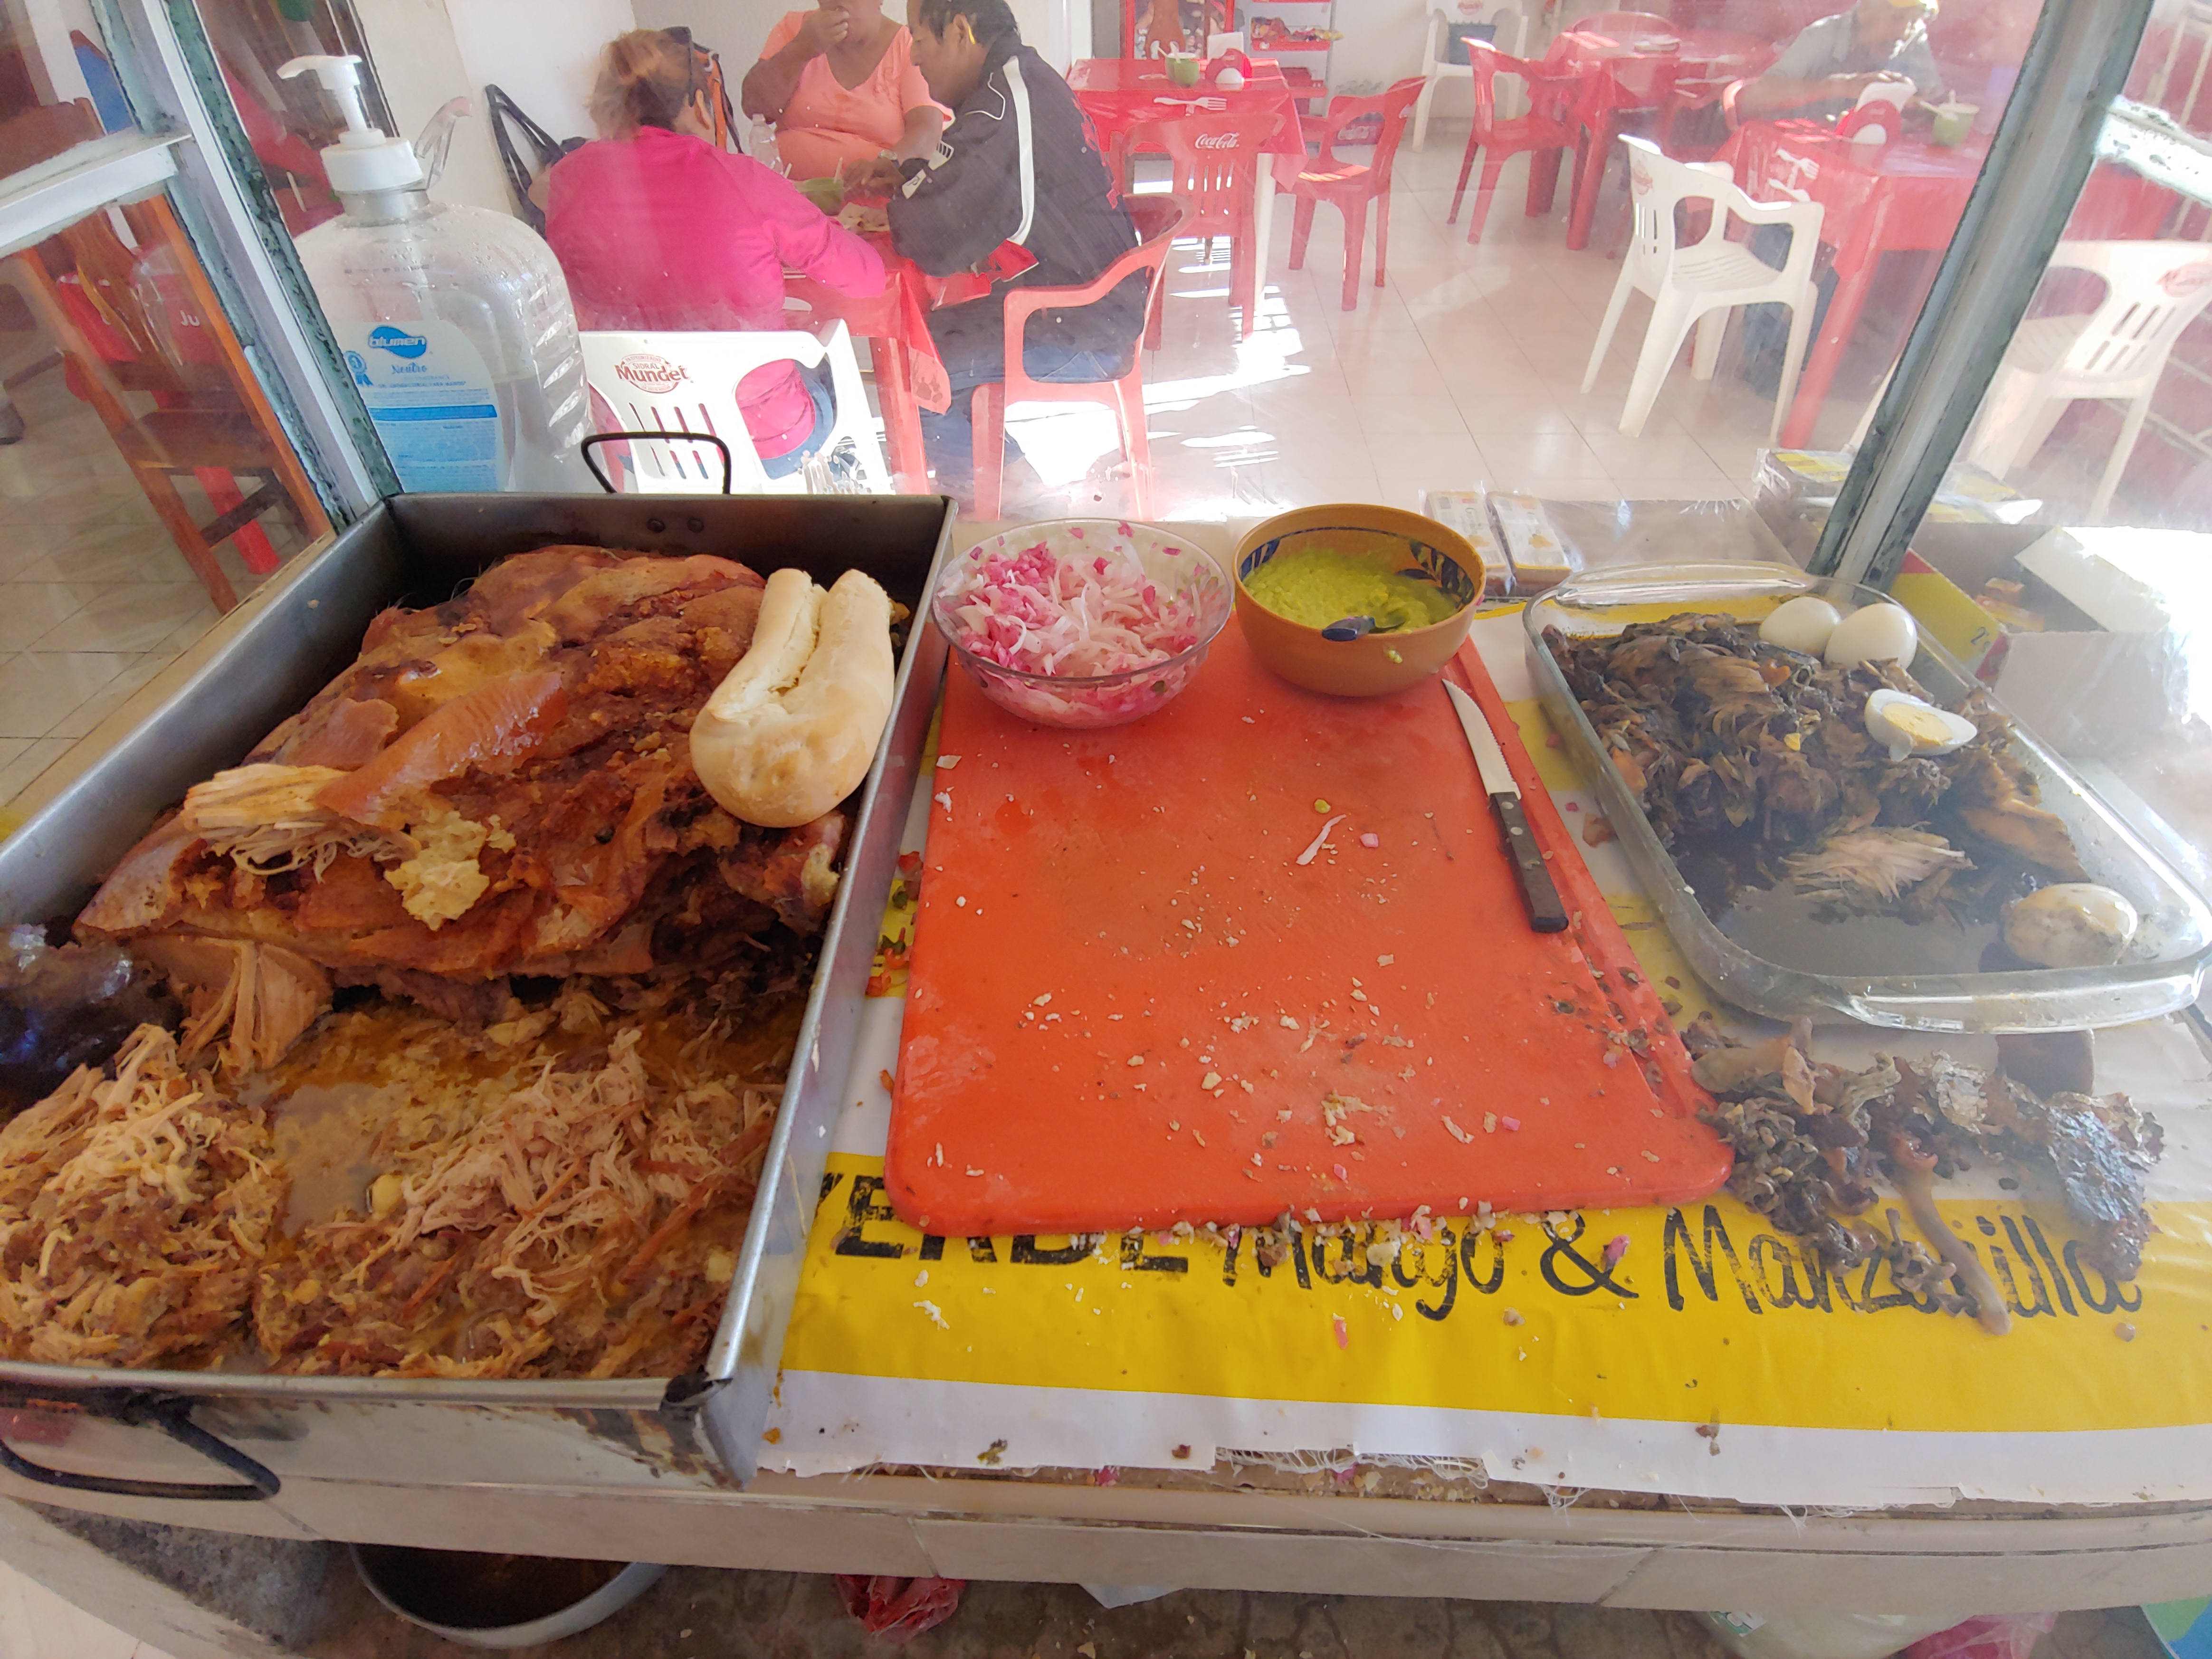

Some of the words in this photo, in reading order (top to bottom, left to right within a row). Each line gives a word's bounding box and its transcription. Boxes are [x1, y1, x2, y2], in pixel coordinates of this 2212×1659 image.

[369, 336, 426, 348] blumen
[614, 363, 689, 382] Mundet
[1540, 1210, 1640, 1299] &
